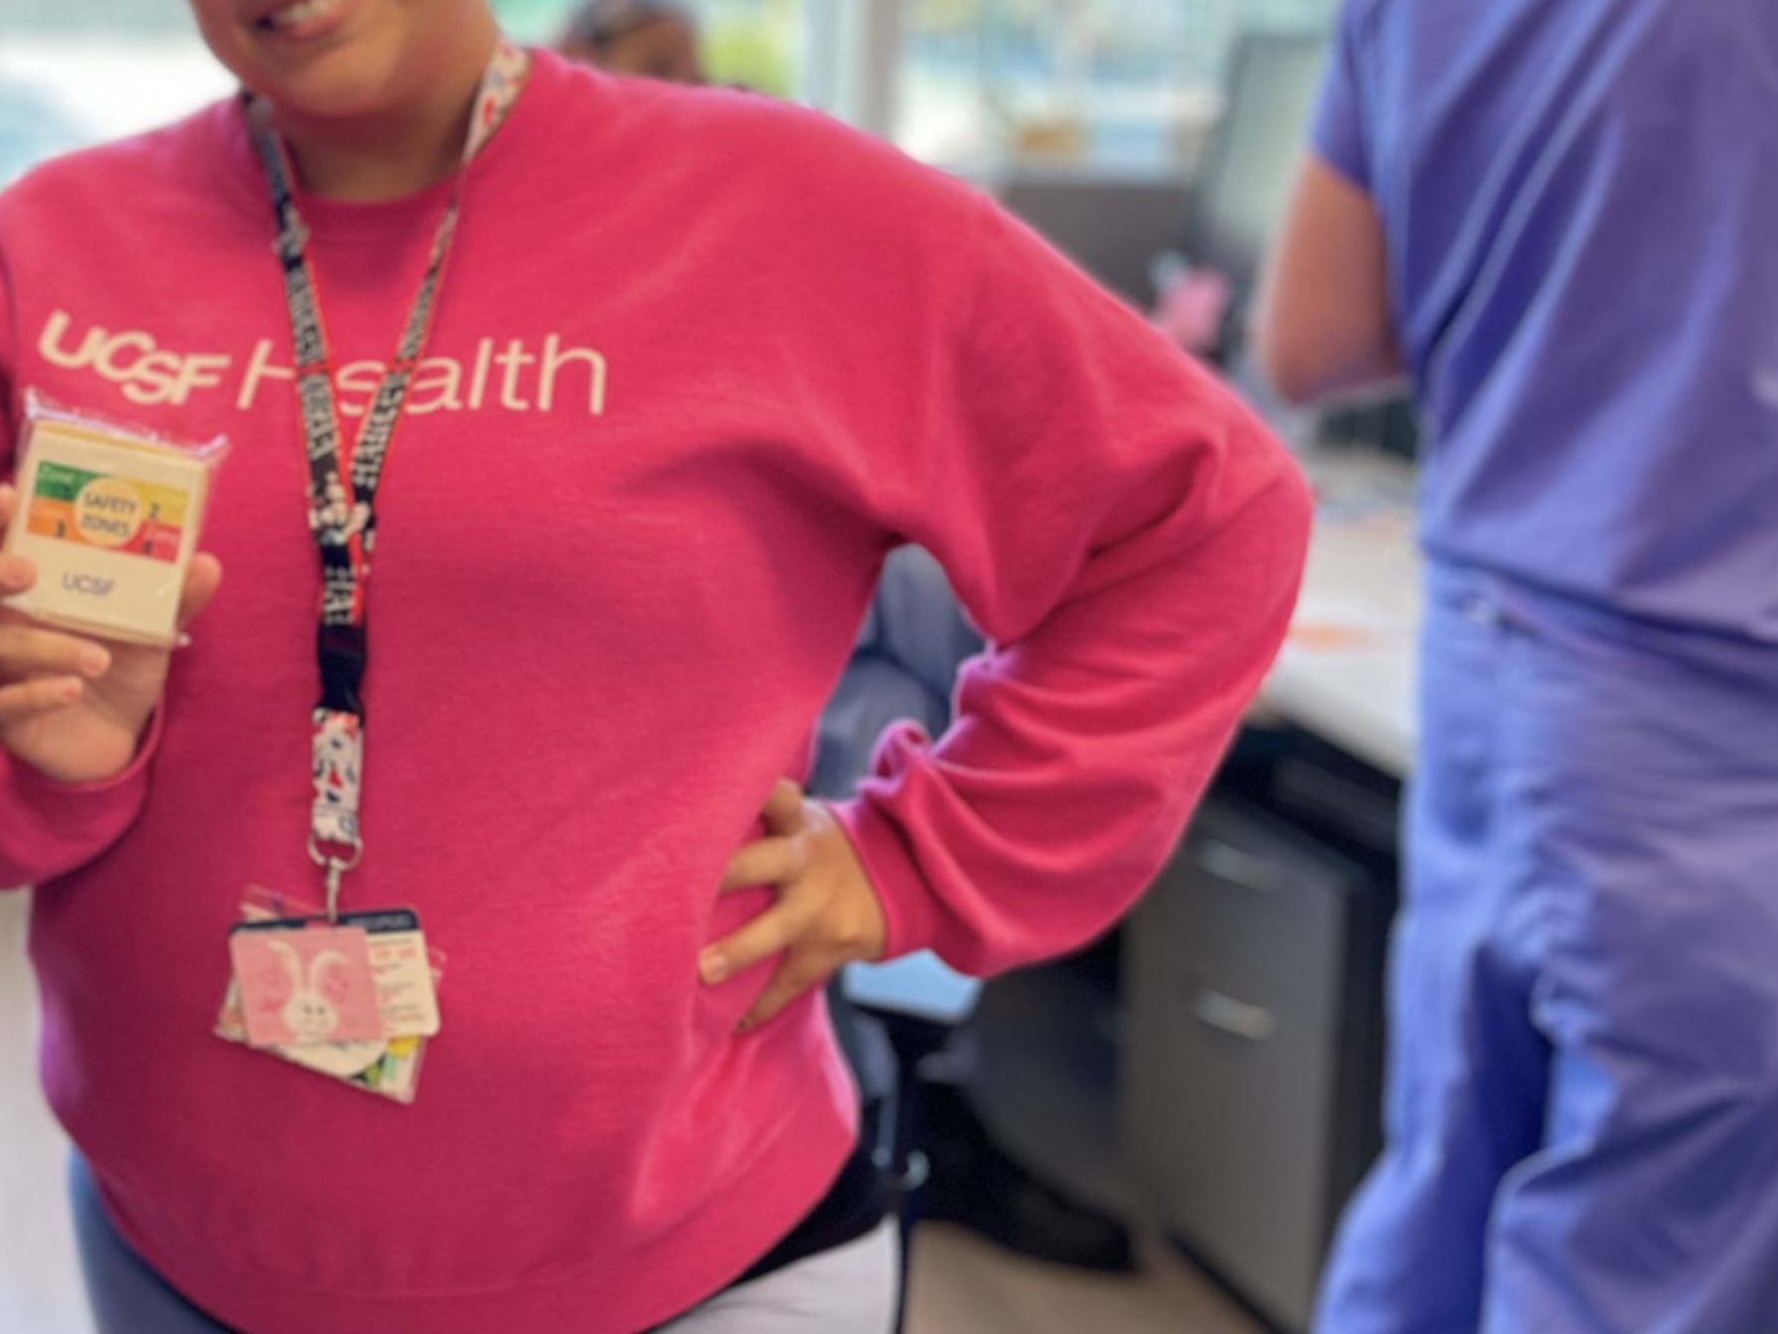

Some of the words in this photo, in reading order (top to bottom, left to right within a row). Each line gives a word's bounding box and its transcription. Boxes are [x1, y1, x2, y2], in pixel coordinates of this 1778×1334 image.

[37, 309, 230, 405] UCSF
[83, 492, 138, 515] SAFETY
[62, 571, 117, 597] UCSF
